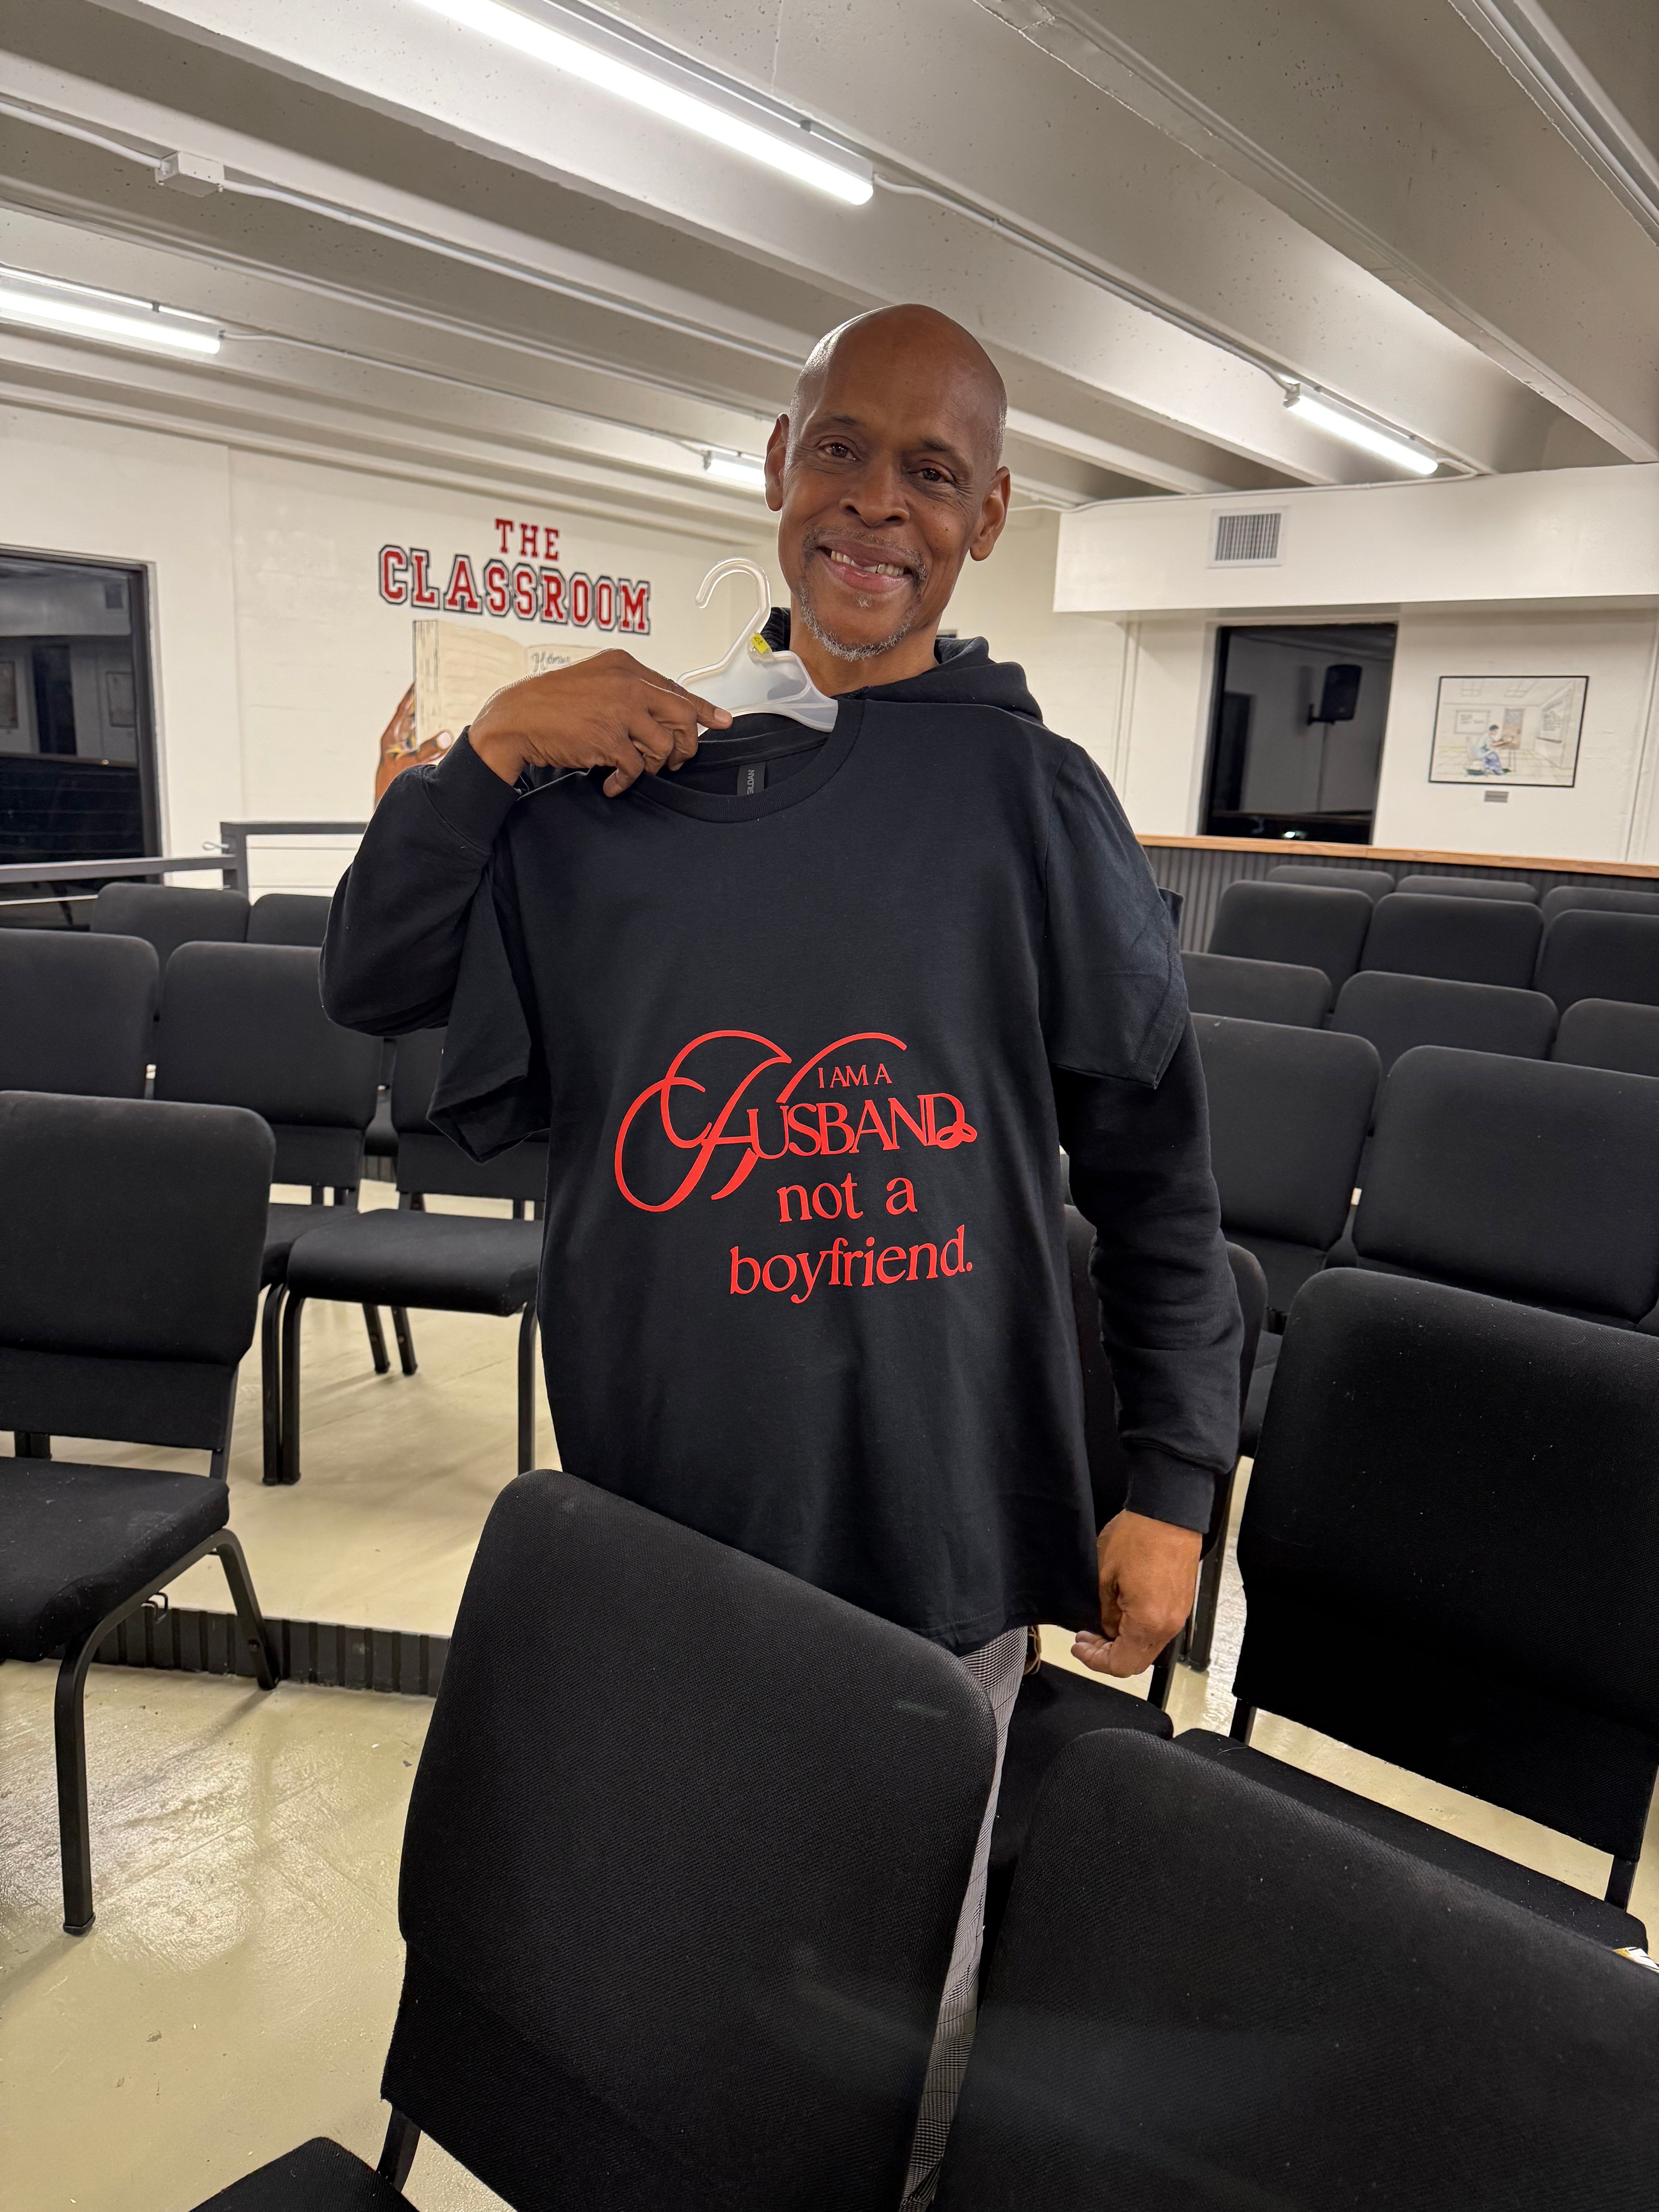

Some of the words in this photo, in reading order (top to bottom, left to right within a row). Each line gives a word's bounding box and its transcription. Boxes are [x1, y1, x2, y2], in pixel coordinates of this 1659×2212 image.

[495, 518, 559, 561] THE
[379, 544, 650, 635] CLASSROOM
[817, 1068, 825, 1089] I
[829, 1065, 868, 1089] AM
[873, 1063, 893, 1086] A
[776, 1173, 864, 1223] not
[885, 1177, 918, 1216] a
[729, 1224, 973, 1304] boyfriend.
